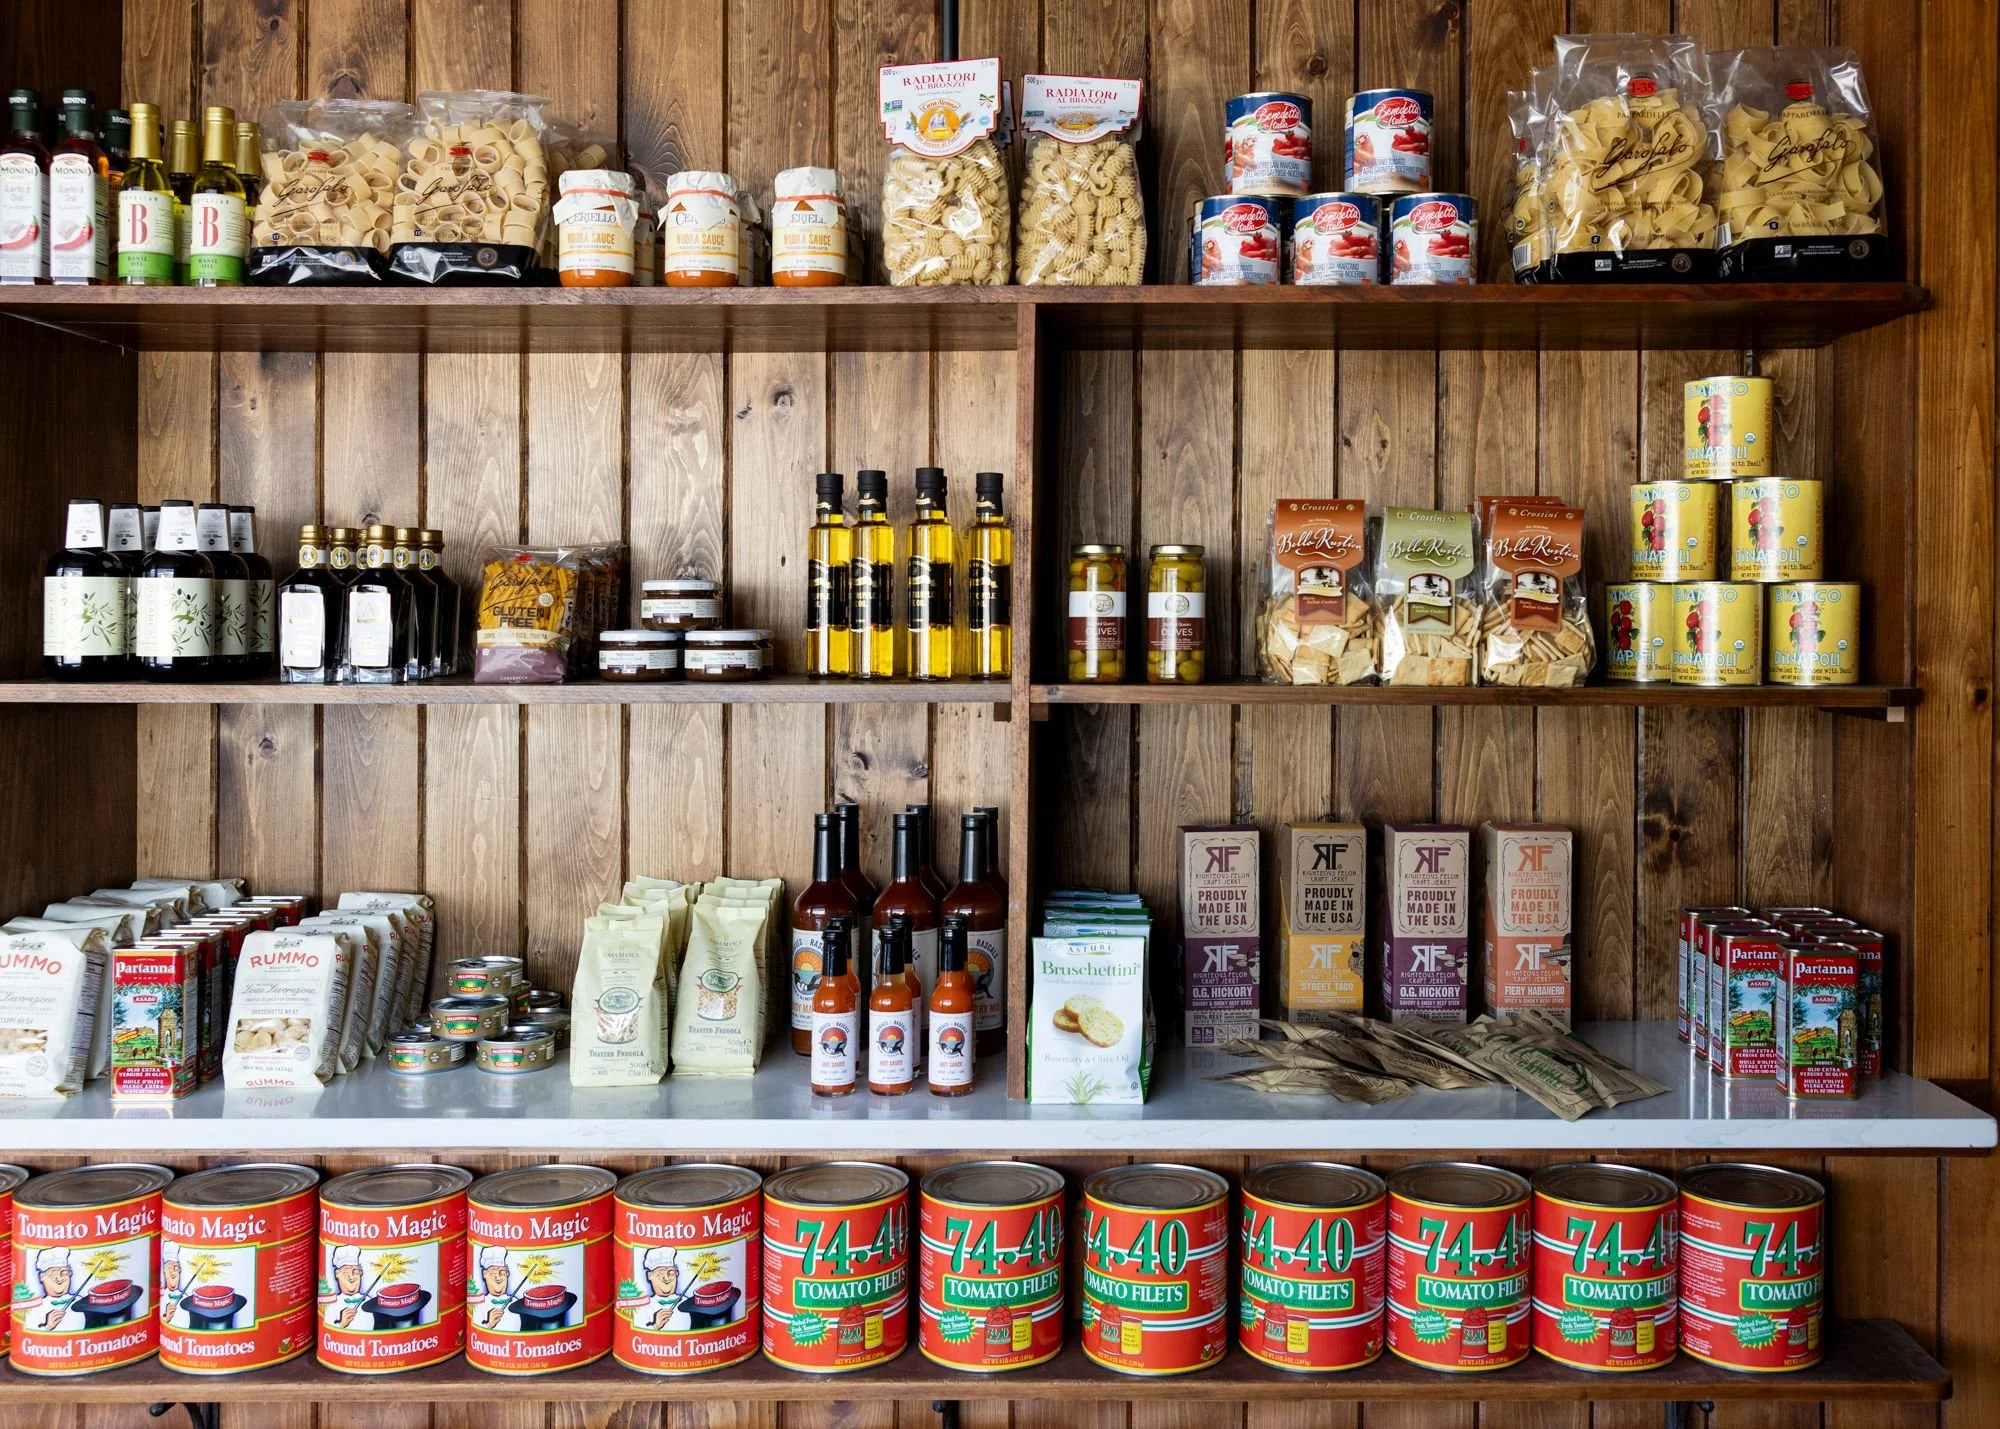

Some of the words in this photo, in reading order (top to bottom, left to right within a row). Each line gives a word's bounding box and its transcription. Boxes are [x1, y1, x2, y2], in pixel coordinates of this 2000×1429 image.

[903, 72, 977, 87] RADIATORI
[927, 81, 965, 89] BRONZO
[1045, 88, 1118, 101] RADIATORI
[1630, 82, 1655, 93] 1-35
[1257, 106, 1301, 123] Benedetta
[1375, 102, 1420, 120] Benedetta
[1268, 117, 1289, 130] Italia
[1386, 112, 1408, 126] Italia
[1596, 131, 1690, 178] Garofalo
[1764, 128, 1850, 171] Garofalo
[1, 166, 34, 176] MONINI
[55, 166, 88, 176] MONINI
[272, 176, 349, 207] Garofalo
[416, 175, 492, 206] Garofalo
[1225, 207, 1268, 224] Benedetta
[1315, 206, 1360, 223] Benedetta
[1413, 206, 1458, 223] Benedetta
[130, 204, 148, 244] B
[201, 206, 219, 248] B
[1235, 219, 1256, 232] Italia
[1327, 217, 1346, 230] Italia
[1423, 217, 1443, 230] Italia
[591, 233, 616, 245] SAUCE
[702, 234, 725, 246] SAUCE
[1687, 381, 1749, 400] BIANCO
[1301, 503, 1339, 511] Crostini
[1520, 509, 1560, 519] Crostini
[1410, 512, 1446, 523] Crostini
[1775, 588, 1842, 603] BIANCO
[492, 606, 545, 618] GLUTEN
[500, 617, 534, 628] FREE
[1775, 651, 1841, 667] DiNAPOLI
[1198, 889, 1247, 902] PROUDLY
[1305, 887, 1353, 899] PROUDLY
[1407, 890, 1456, 902] PROUDLY
[1511, 888, 1559, 900] PROUDLY
[1198, 902, 1234, 914] MADE
[1236, 902, 1247, 913] IN
[1305, 900, 1337, 911] MADE
[1342, 900, 1353, 911] IN
[1407, 903, 1441, 914] MADE
[1445, 903, 1456, 914] IN
[1511, 901, 1543, 912] MADE
[1547, 901, 1559, 912] IN
[1198, 915, 1221, 926] THE
[1224, 914, 1247, 926] USA
[1305, 913, 1327, 924] THE
[1331, 912, 1353, 923] USA
[1407, 915, 1429, 926] THE
[1433, 914, 1456, 926] USA
[1511, 914, 1532, 924] THE
[1537, 913, 1559, 924] USA
[0, 953, 62, 975] UMMO
[250, 951, 320, 969] RUMMO
[115, 961, 175, 978] Partanna
[1042, 960, 1137, 976] Bruschettini
[1795, 962, 1854, 978] Partanna
[1193, 987, 1210, 998] O.G.
[1211, 986, 1253, 998] HICKORY
[1301, 982, 1332, 991] STREET
[1334, 982, 1353, 991] TACO
[1400, 986, 1417, 998] O.G.
[1419, 986, 1460, 998] HICKORY
[1505, 985, 1526, 995] FIERY
[1528, 985, 1564, 995] HABANERO
[1044, 1054, 1083, 1064] Rosemary
[1092, 1054, 1114, 1063] Olive
[1116, 1054, 1129, 1063] Oil
[246, 1078, 295, 1087] RUMMO
[18, 1212, 89, 1240] Tomato
[95, 1205, 156, 1238] Magic
[200, 1213, 266, 1243] Magic
[320, 1208, 380, 1240] Tomato
[386, 1208, 447, 1240] Magic
[468, 1207, 523, 1241] Tomato
[529, 1210, 590, 1241] Magic
[626, 1211, 696, 1240] Tomato
[702, 1206, 752, 1239] Magic
[799, 1279, 871, 1299] TOMATO
[873, 1268, 908, 1296] FILETS
[947, 1278, 1019, 1299] TOMATO
[1022, 1266, 1059, 1297] FILETS
[1084, 1266, 1128, 1299] TOMATO
[1131, 1284, 1184, 1303] FILETS
[1243, 1266, 1295, 1299] TOMATO
[1298, 1282, 1350, 1302] FILETS
[1422, 1278, 1495, 1300] TOMATO
[1568, 1278, 1642, 1300] TOMATO
[1747, 1280, 1812, 1301] TOMATO
[693, 1295, 716, 1306] Tomato
[22, 1336, 73, 1358] Ground
[76, 1328, 148, 1356] Tomatoes
[186, 1338, 255, 1357] Tomatoes
[323, 1332, 366, 1358] Ground
[369, 1334, 439, 1359] Tomatoes
[471, 1331, 510, 1358] Ground
[514, 1333, 582, 1359] Tomatoes
[632, 1335, 685, 1358] Ground
[686, 1330, 747, 1357] Tomatoes
